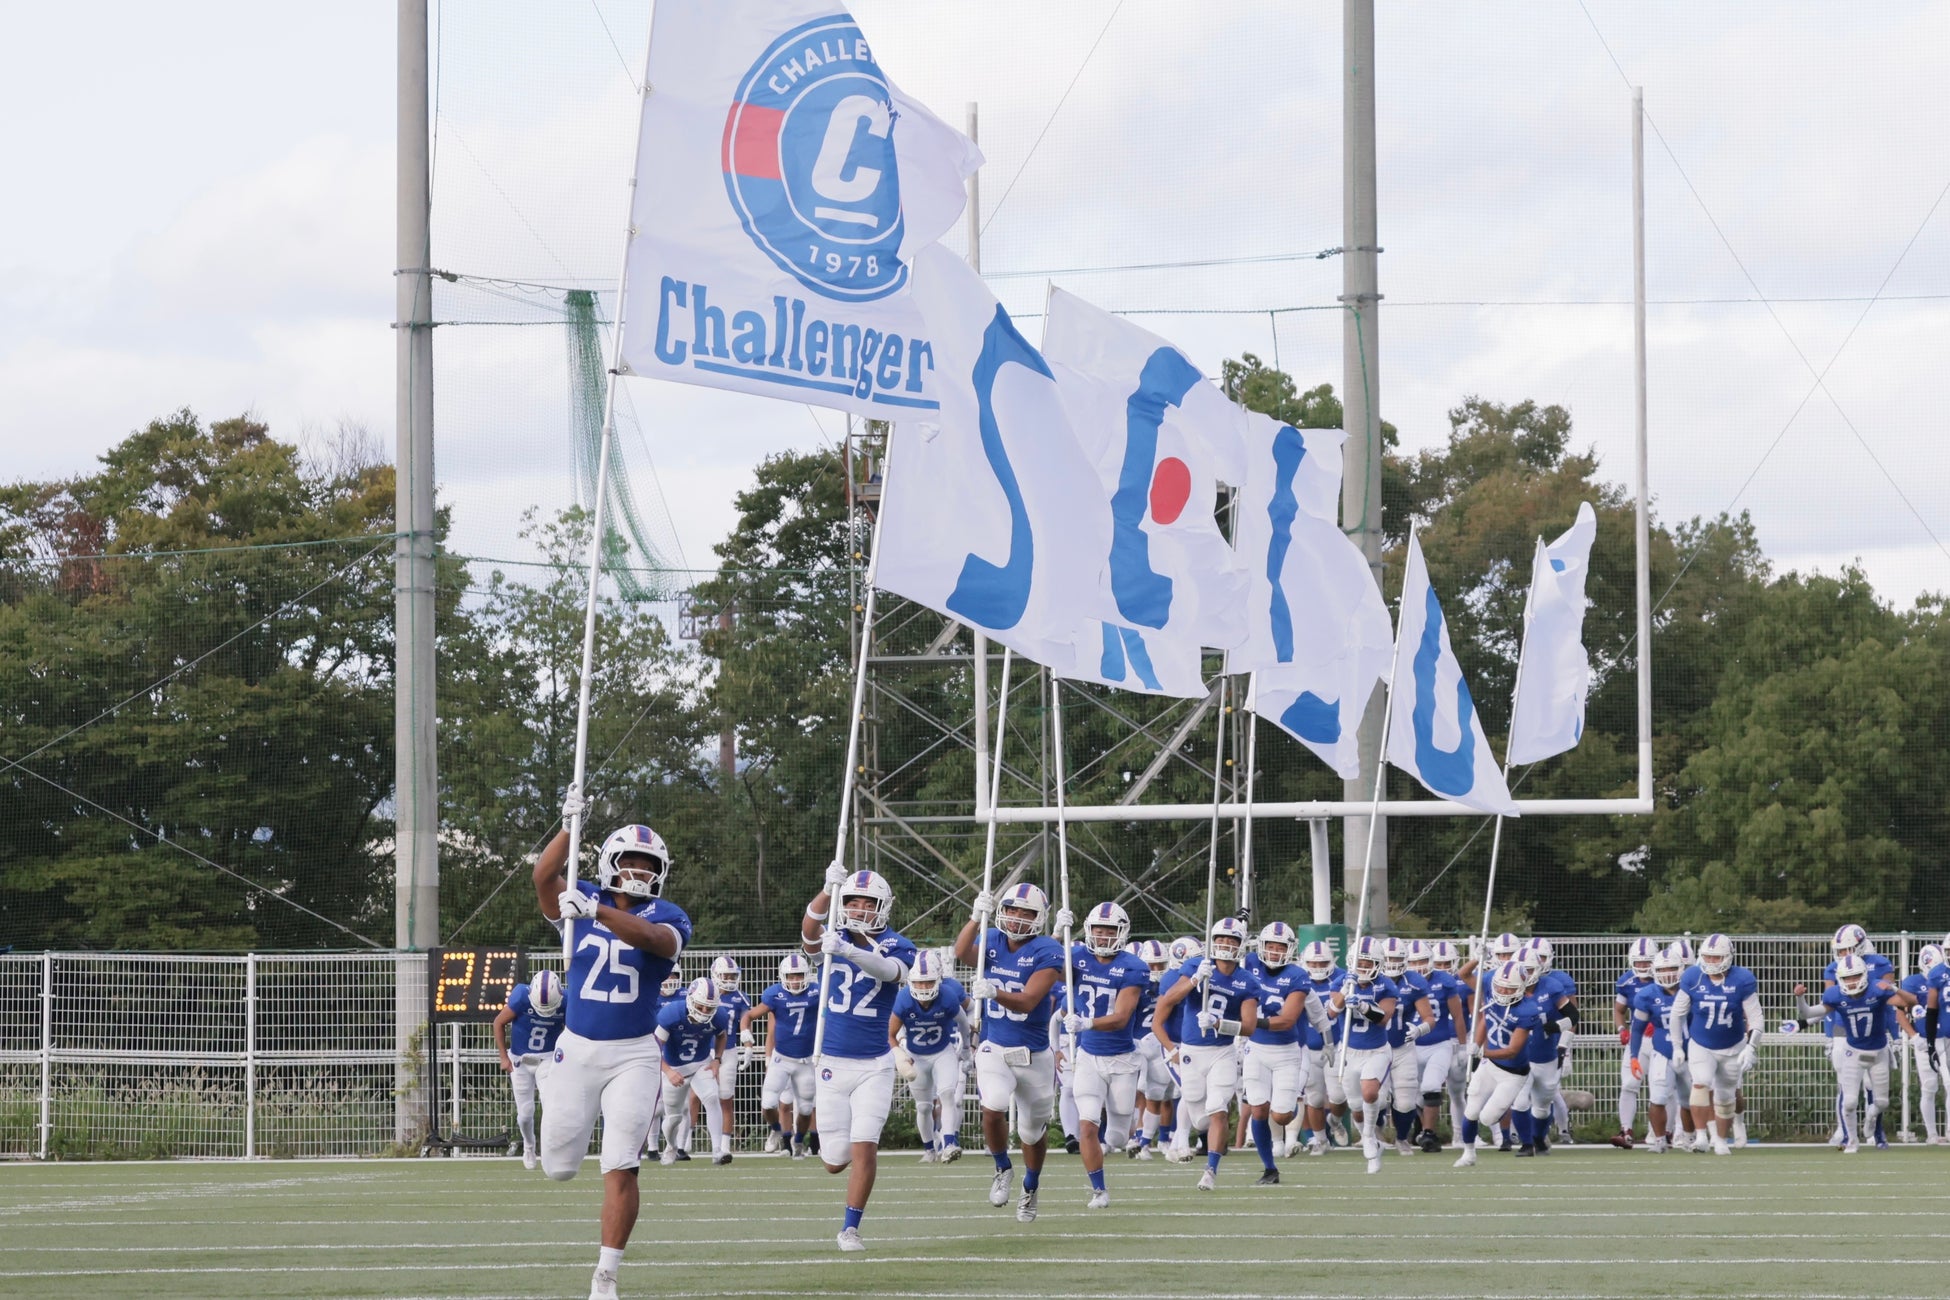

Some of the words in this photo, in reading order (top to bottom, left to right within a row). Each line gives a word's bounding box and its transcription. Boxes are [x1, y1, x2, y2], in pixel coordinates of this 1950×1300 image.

[768, 38, 878, 95] CHALLE
[808, 245, 880, 278] 1978
[654, 275, 935, 400] Challenger
[435, 952, 518, 1011] 25
[576, 933, 640, 1003] 25
[828, 963, 883, 1017] 32
[1078, 984, 1117, 1020] 37
[789, 1007, 806, 1036] 7
[1700, 1002, 1734, 1029] 74
[1848, 1012, 1874, 1038] 17
[528, 1026, 548, 1051] 8
[679, 1039, 698, 1061] 3
[909, 1025, 943, 1046] 23
